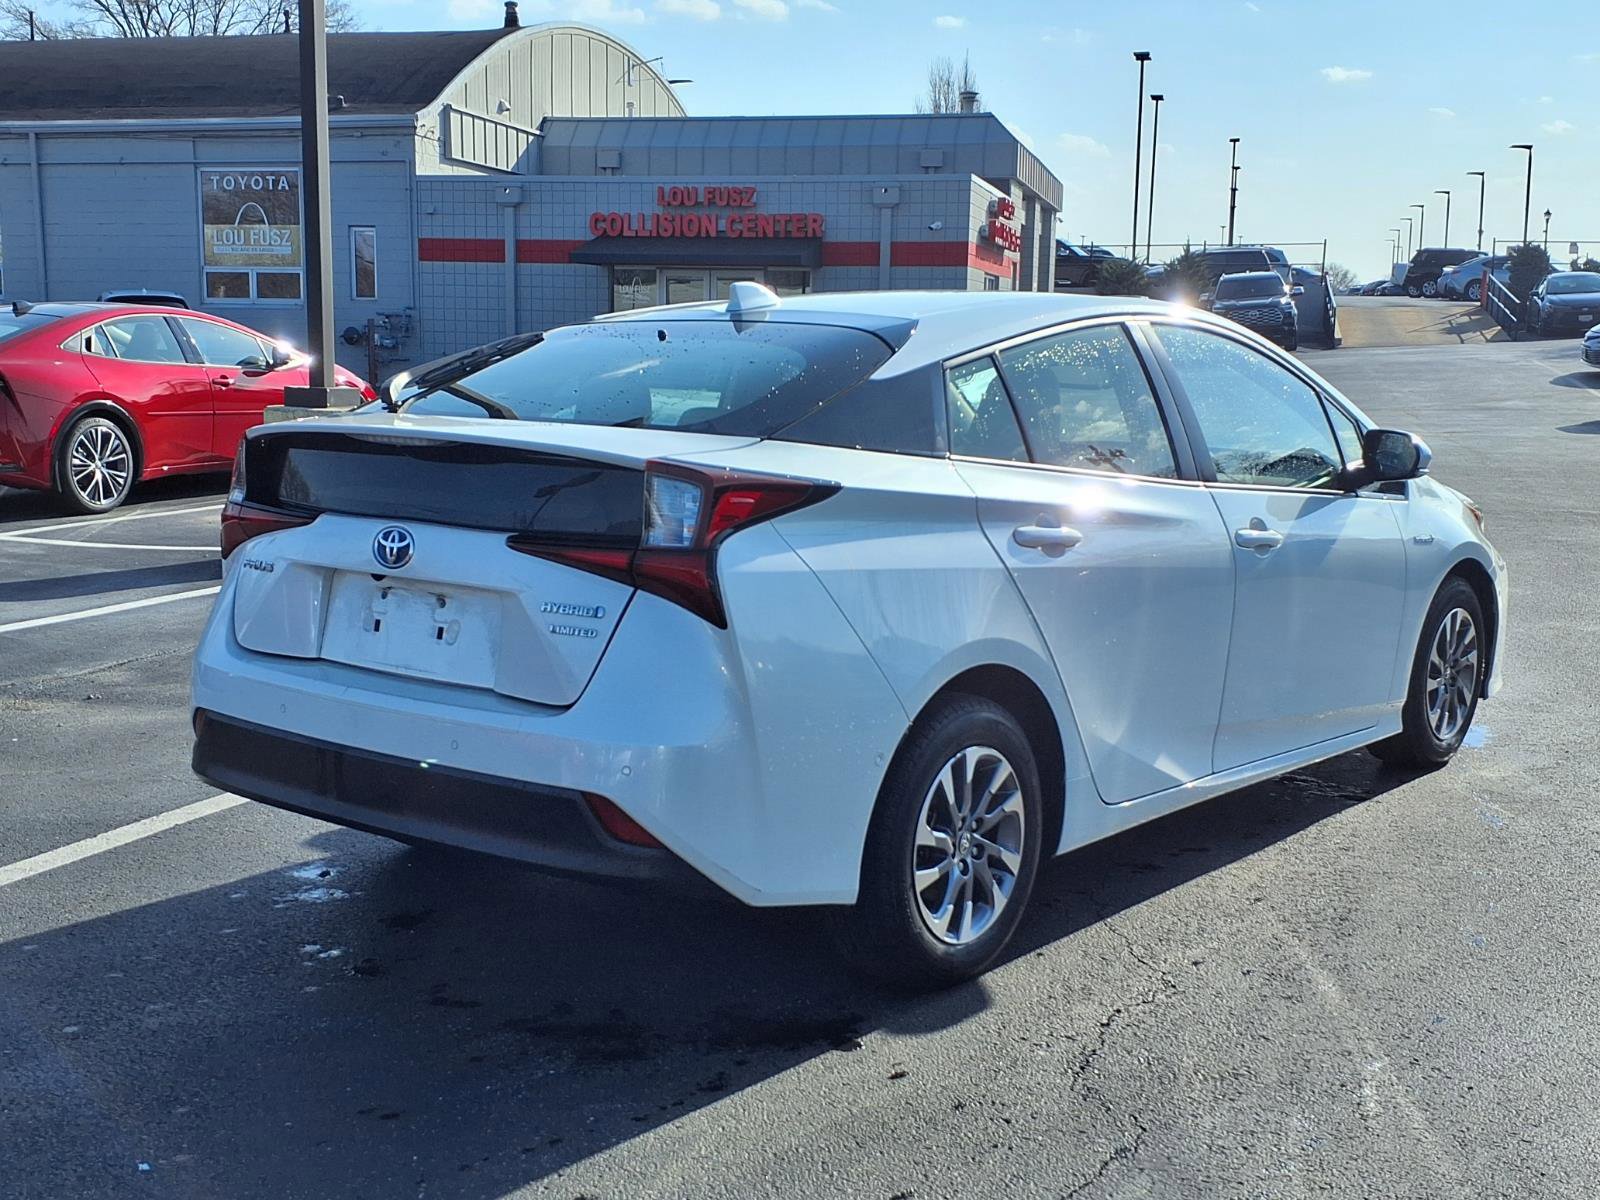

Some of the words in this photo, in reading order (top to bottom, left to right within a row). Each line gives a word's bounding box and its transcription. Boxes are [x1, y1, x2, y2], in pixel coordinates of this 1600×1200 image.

[210, 175, 290, 191] TOYOTA
[656, 186, 699, 207] LOU
[703, 186, 758, 208] FUSZ
[589, 211, 719, 238] COLLISION
[725, 213, 824, 239] CENTER
[213, 229, 245, 245] LOU
[250, 229, 292, 246] FUSZ
[540, 601, 595, 618] HYBRID
[548, 624, 598, 638] LIMITED
